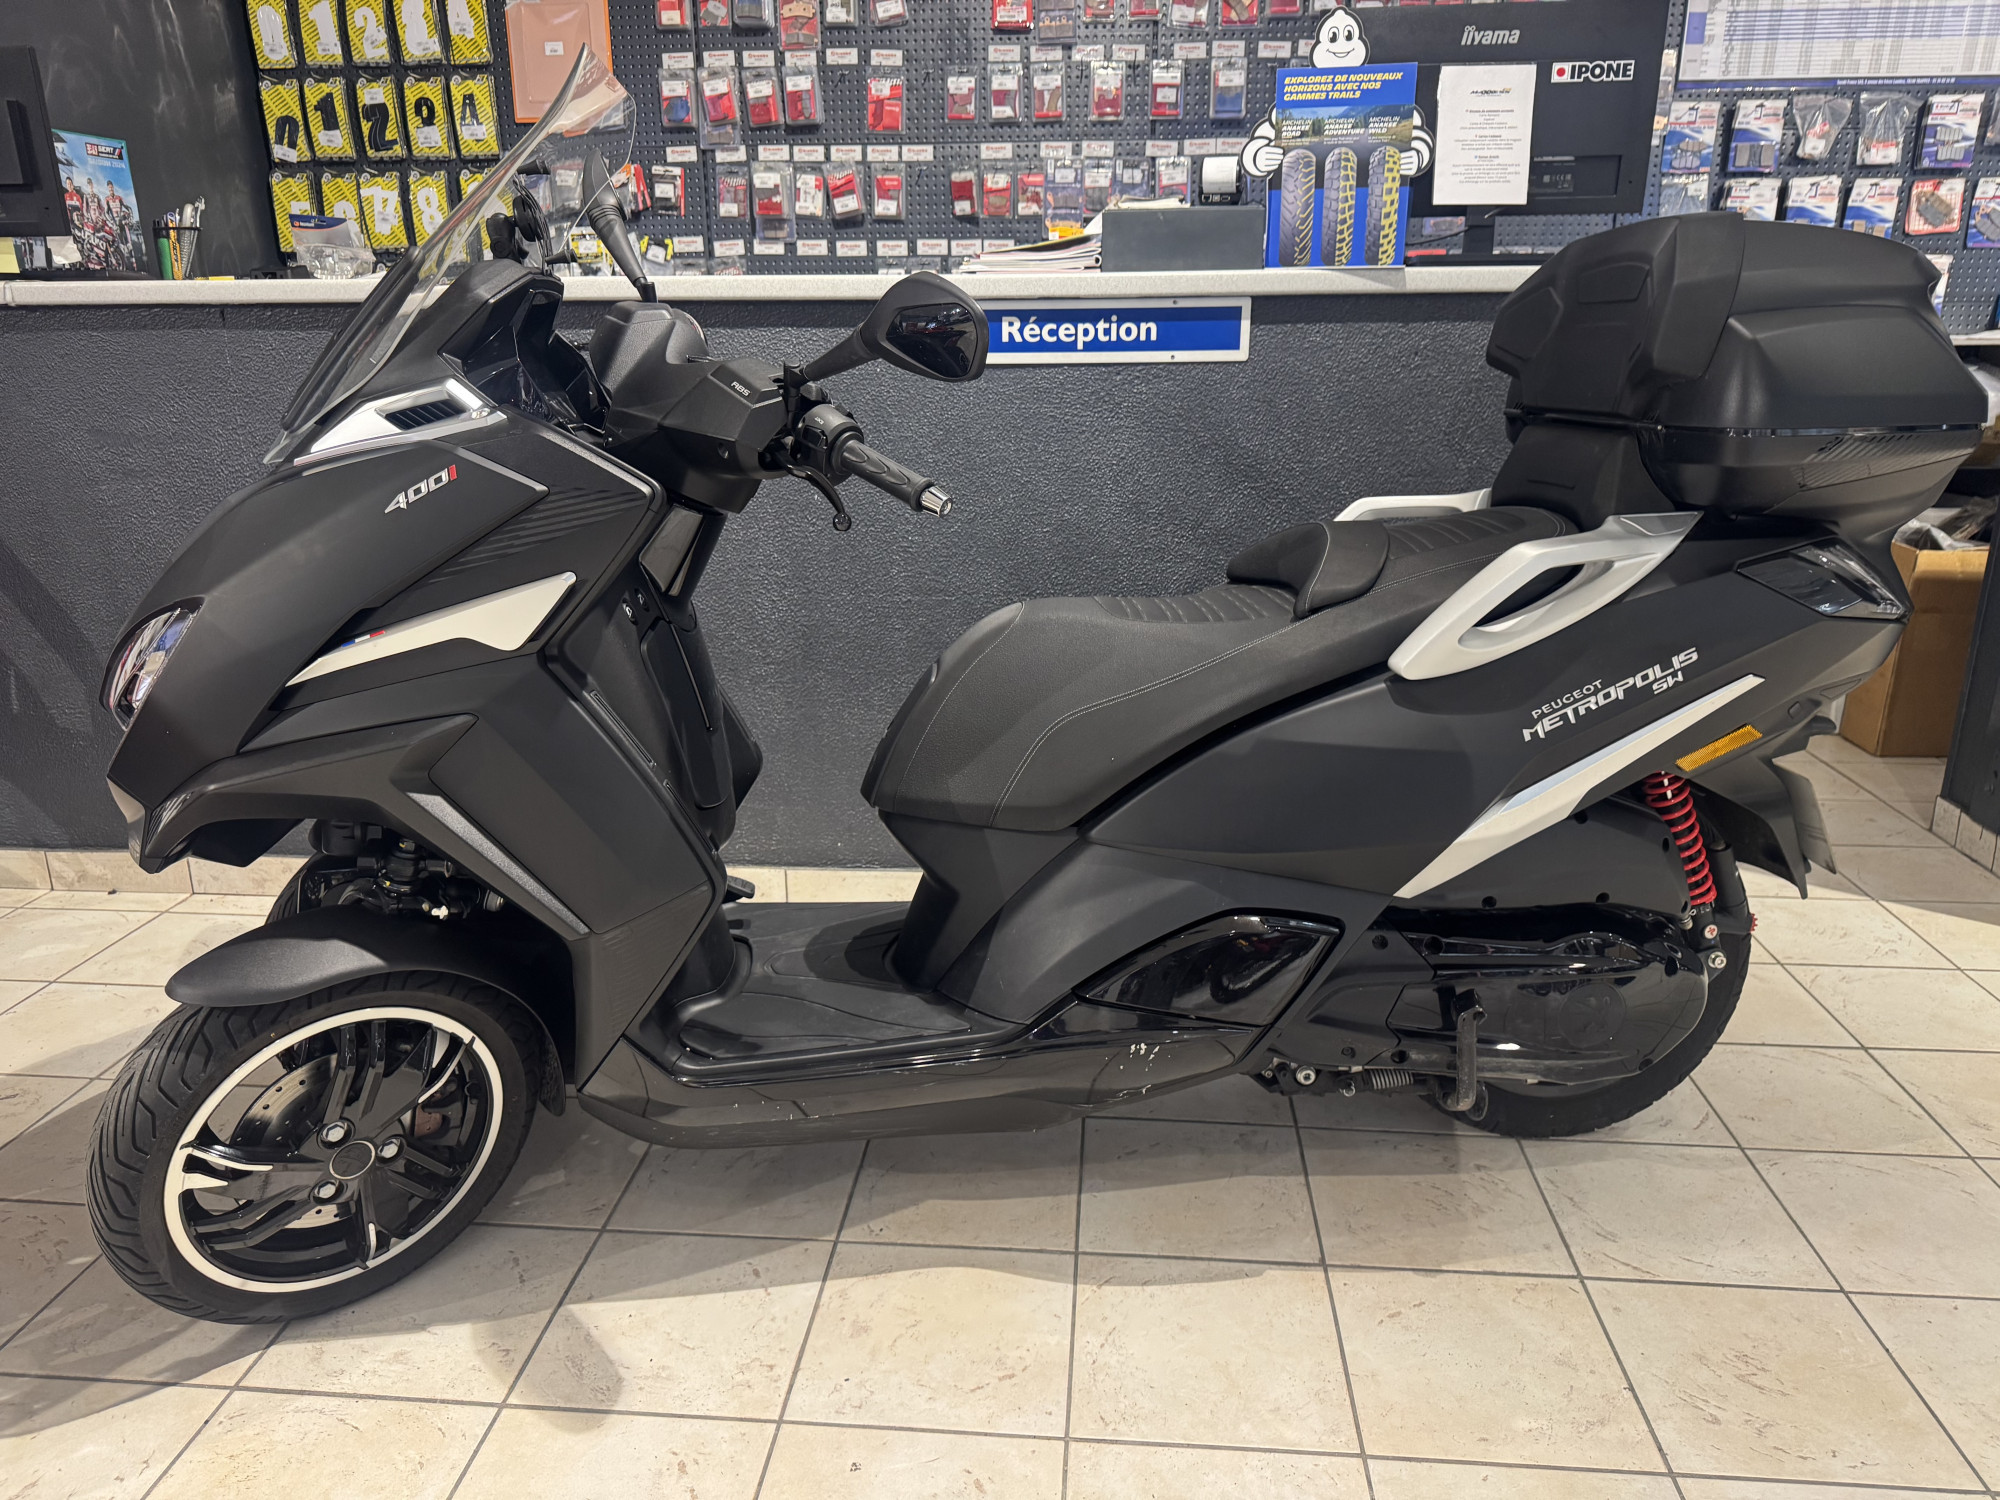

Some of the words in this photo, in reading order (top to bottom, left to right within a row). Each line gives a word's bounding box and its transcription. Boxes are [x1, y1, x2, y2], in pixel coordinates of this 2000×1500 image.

[1461, 25, 1520, 46] iiyama
[1284, 75, 1334, 84] EXPLOREZ
[1334, 74, 1348, 83] DE
[1349, 72, 1403, 82] NOUVEAUX
[1570, 62, 1634, 81] IPONE
[1284, 84, 1333, 93] HORIZONS
[1334, 82, 1360, 91] AVEC
[1360, 81, 1382, 90] NOS
[1284, 92, 1327, 101] GAMMES
[1328, 90, 1361, 99] TRAILS
[314, 92, 340, 131] 1
[1324, 128, 1365, 136] ADVENTURE
[1001, 315, 1157, 350] Réception
[730, 381, 751, 396] ABS
[384, 464, 458, 514] 400i
[1652, 671, 1684, 695] SW
[1522, 647, 1699, 742] METROPOLIS
[1531, 679, 1602, 719] PEUGEOT
